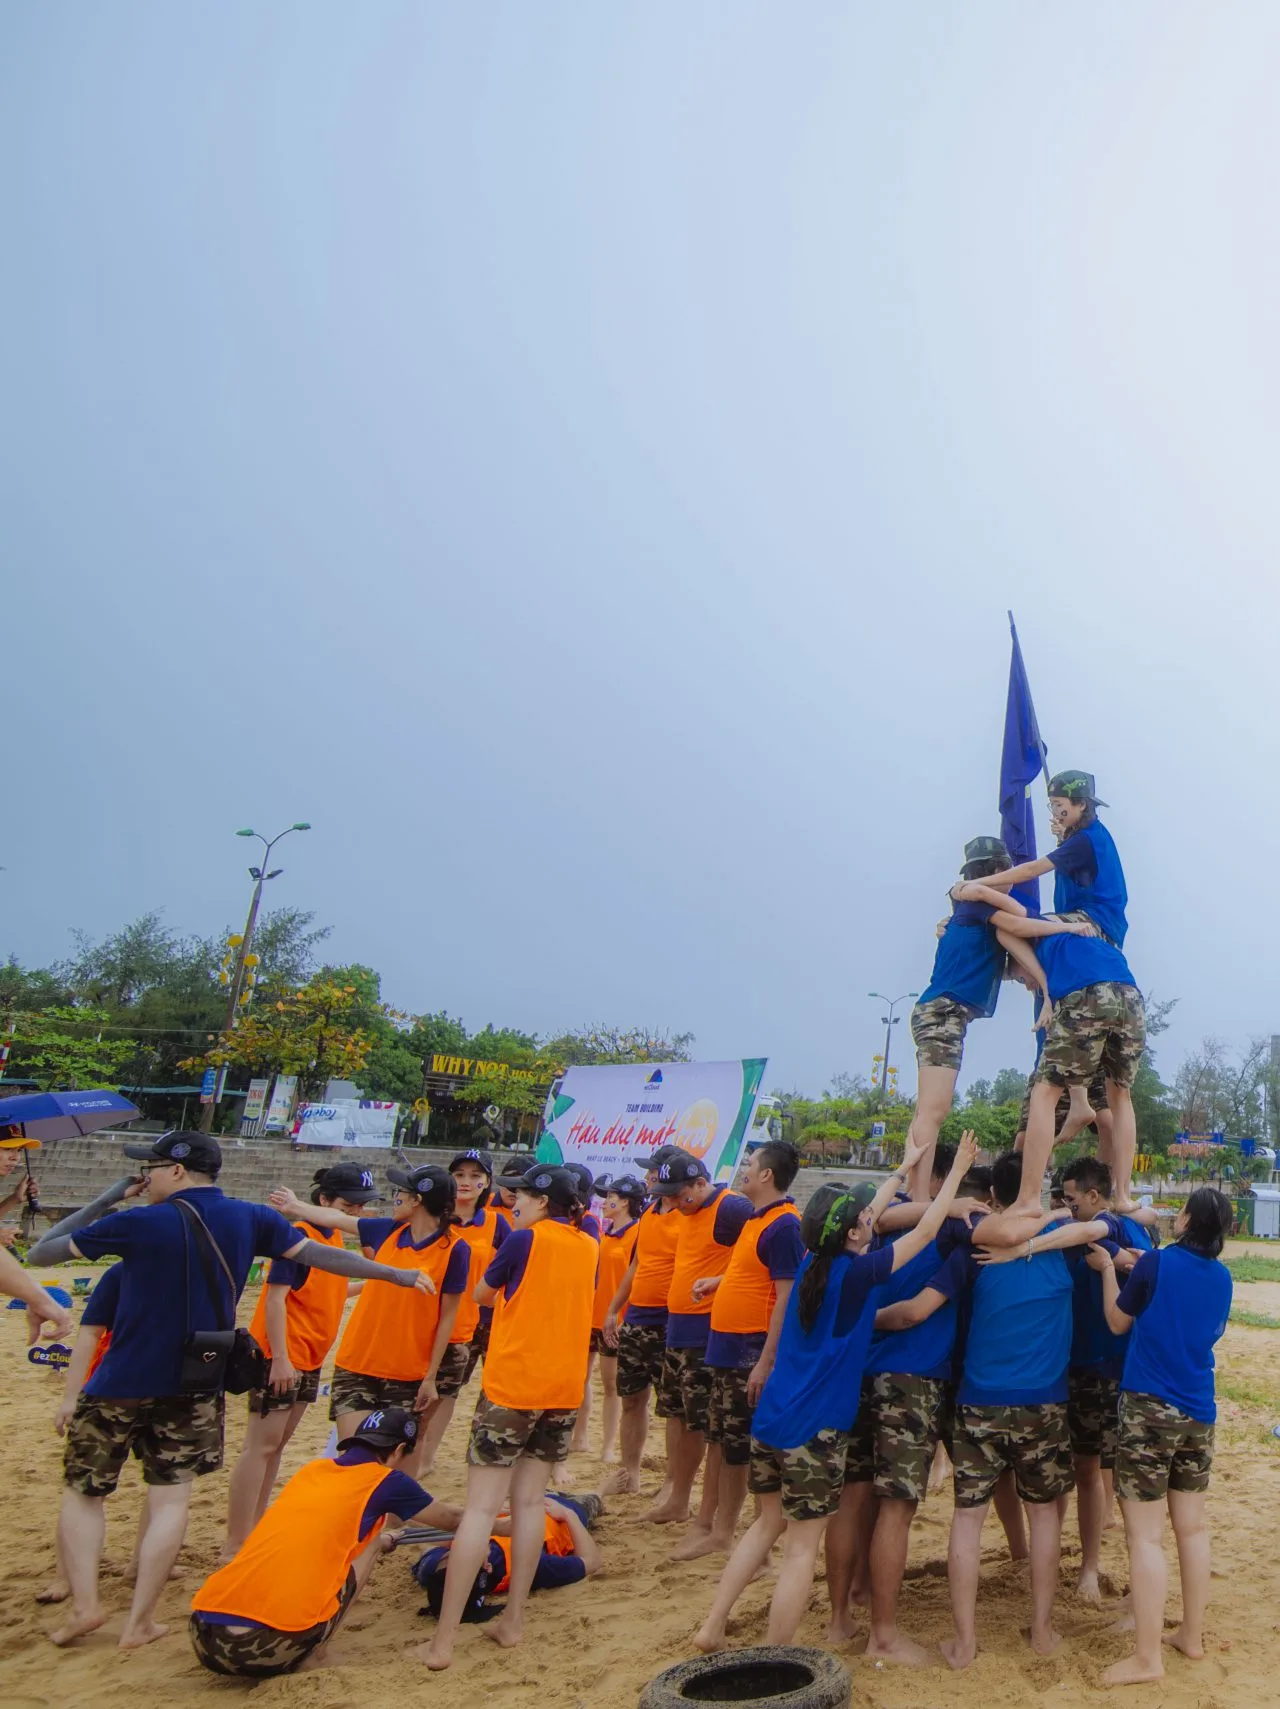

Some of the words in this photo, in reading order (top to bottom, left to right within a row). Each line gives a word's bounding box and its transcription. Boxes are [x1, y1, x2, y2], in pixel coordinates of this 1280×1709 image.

[432, 1054, 474, 1076] WHY
[475, 1060, 509, 1079] NOT
[626, 1103, 640, 1112] TEAM
[640, 1103, 664, 1112] BUILDING
[33, 1351, 71, 1363] #ezClou
